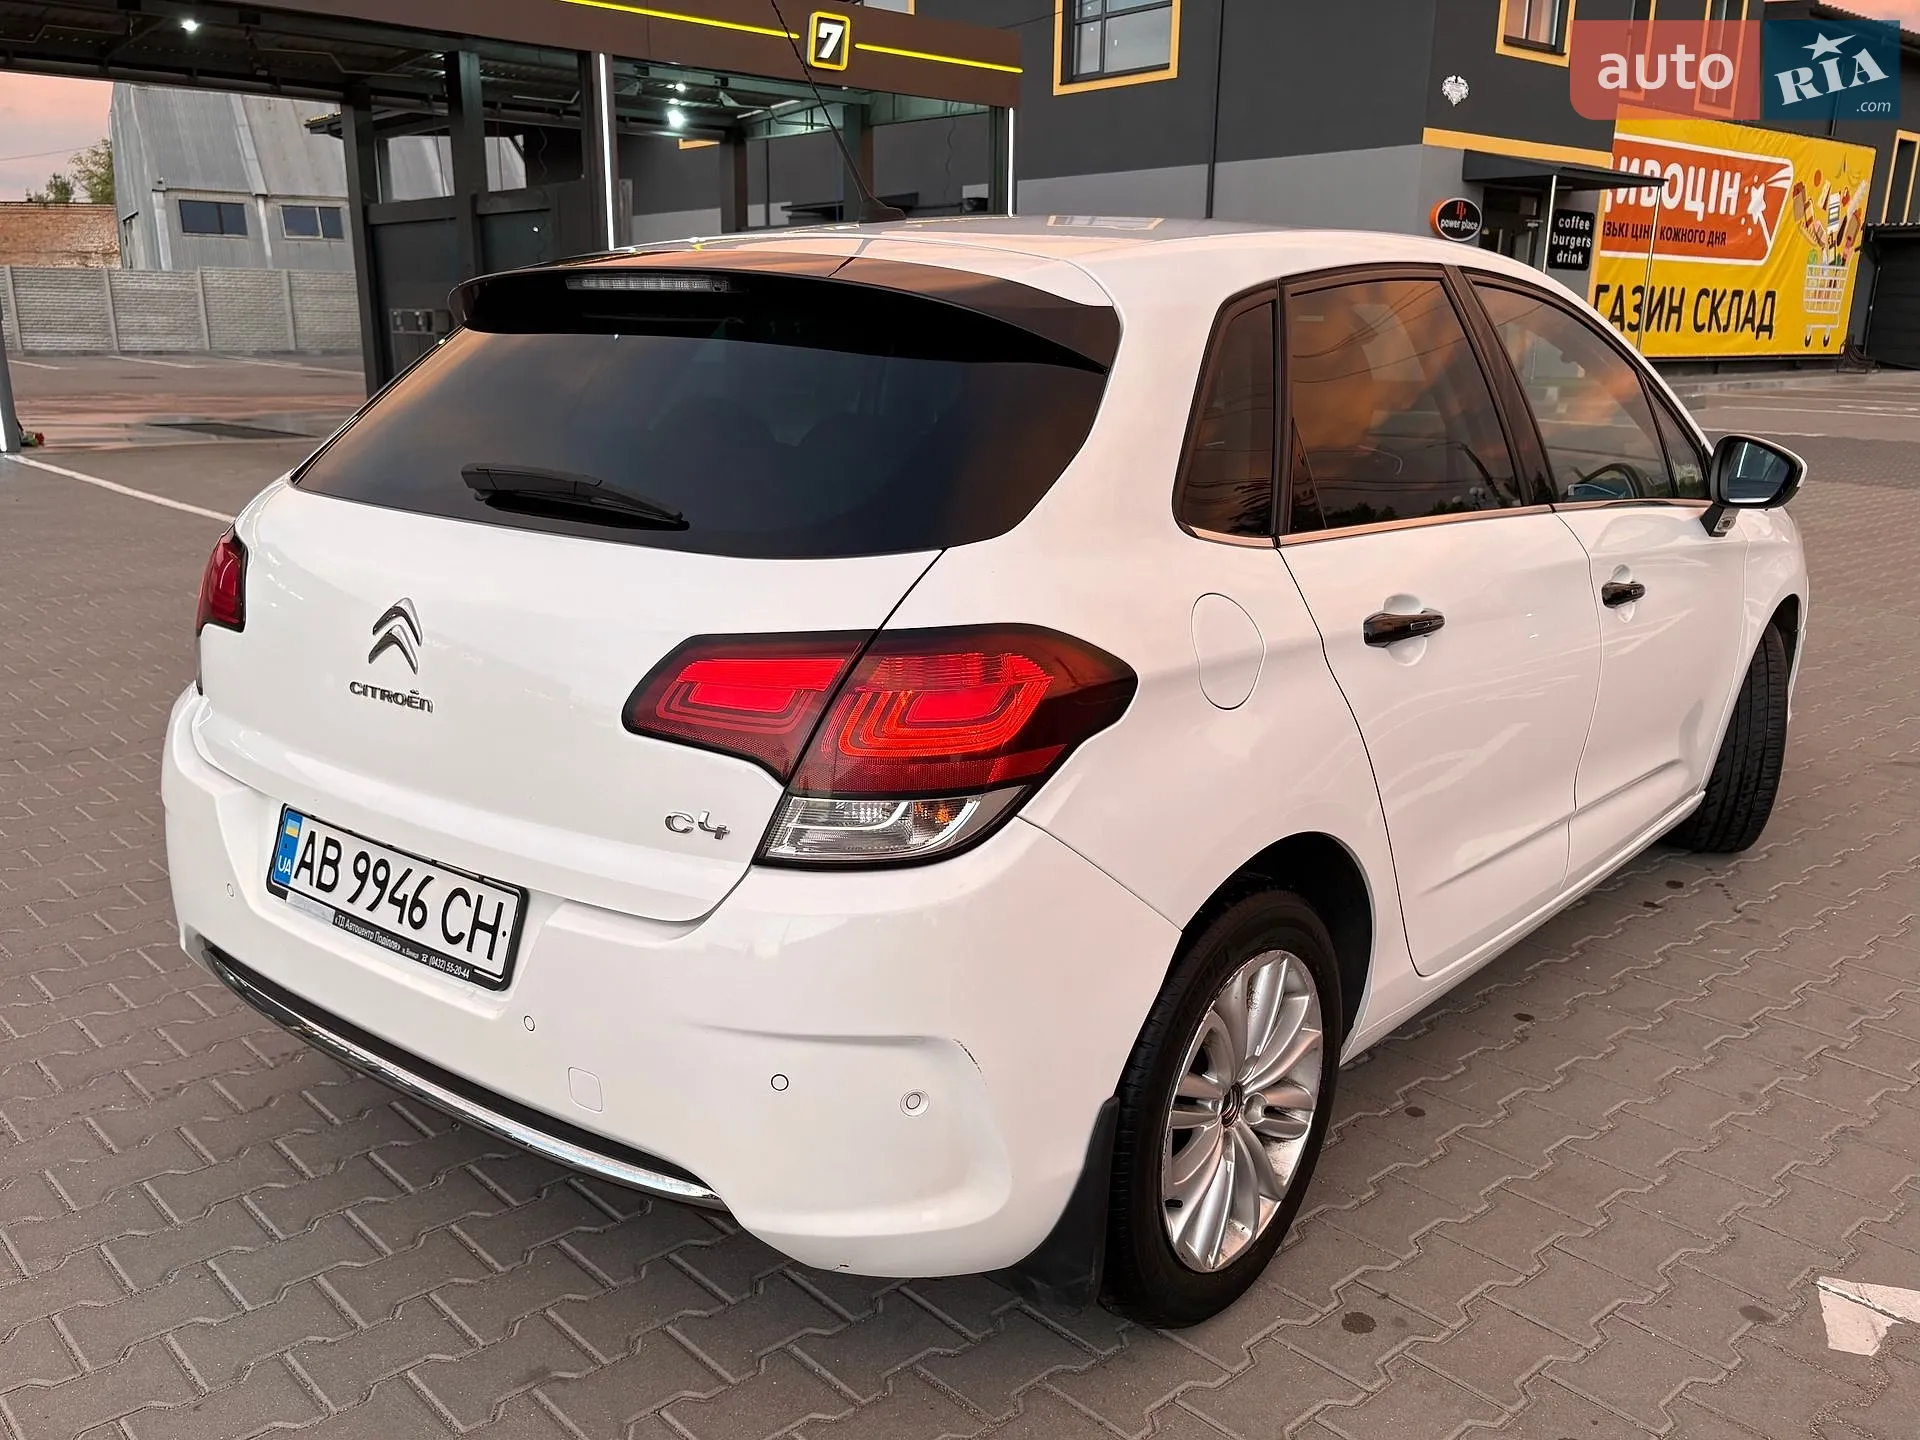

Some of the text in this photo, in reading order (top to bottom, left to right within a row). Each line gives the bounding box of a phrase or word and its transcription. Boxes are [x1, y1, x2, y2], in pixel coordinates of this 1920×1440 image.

[817, 22, 844, 59] 7
[1604, 155, 1742, 222] ИВОЦІН
[1440, 219, 1479, 232] power place
[1558, 215, 1590, 231] coffee
[1602, 221, 1630, 239] ЗЬКІ
[1659, 225, 1706, 244] КОЖНОГО
[1707, 231, 1727, 248] ДНЯ
[1552, 232, 1592, 250] burgers
[1556, 250, 1584, 265] drink
[1692, 287, 1777, 341] СКЛАД
[664, 810, 731, 841] C4
[277, 855, 292, 876] UA
[293, 830, 505, 961] AB 9946 CH
